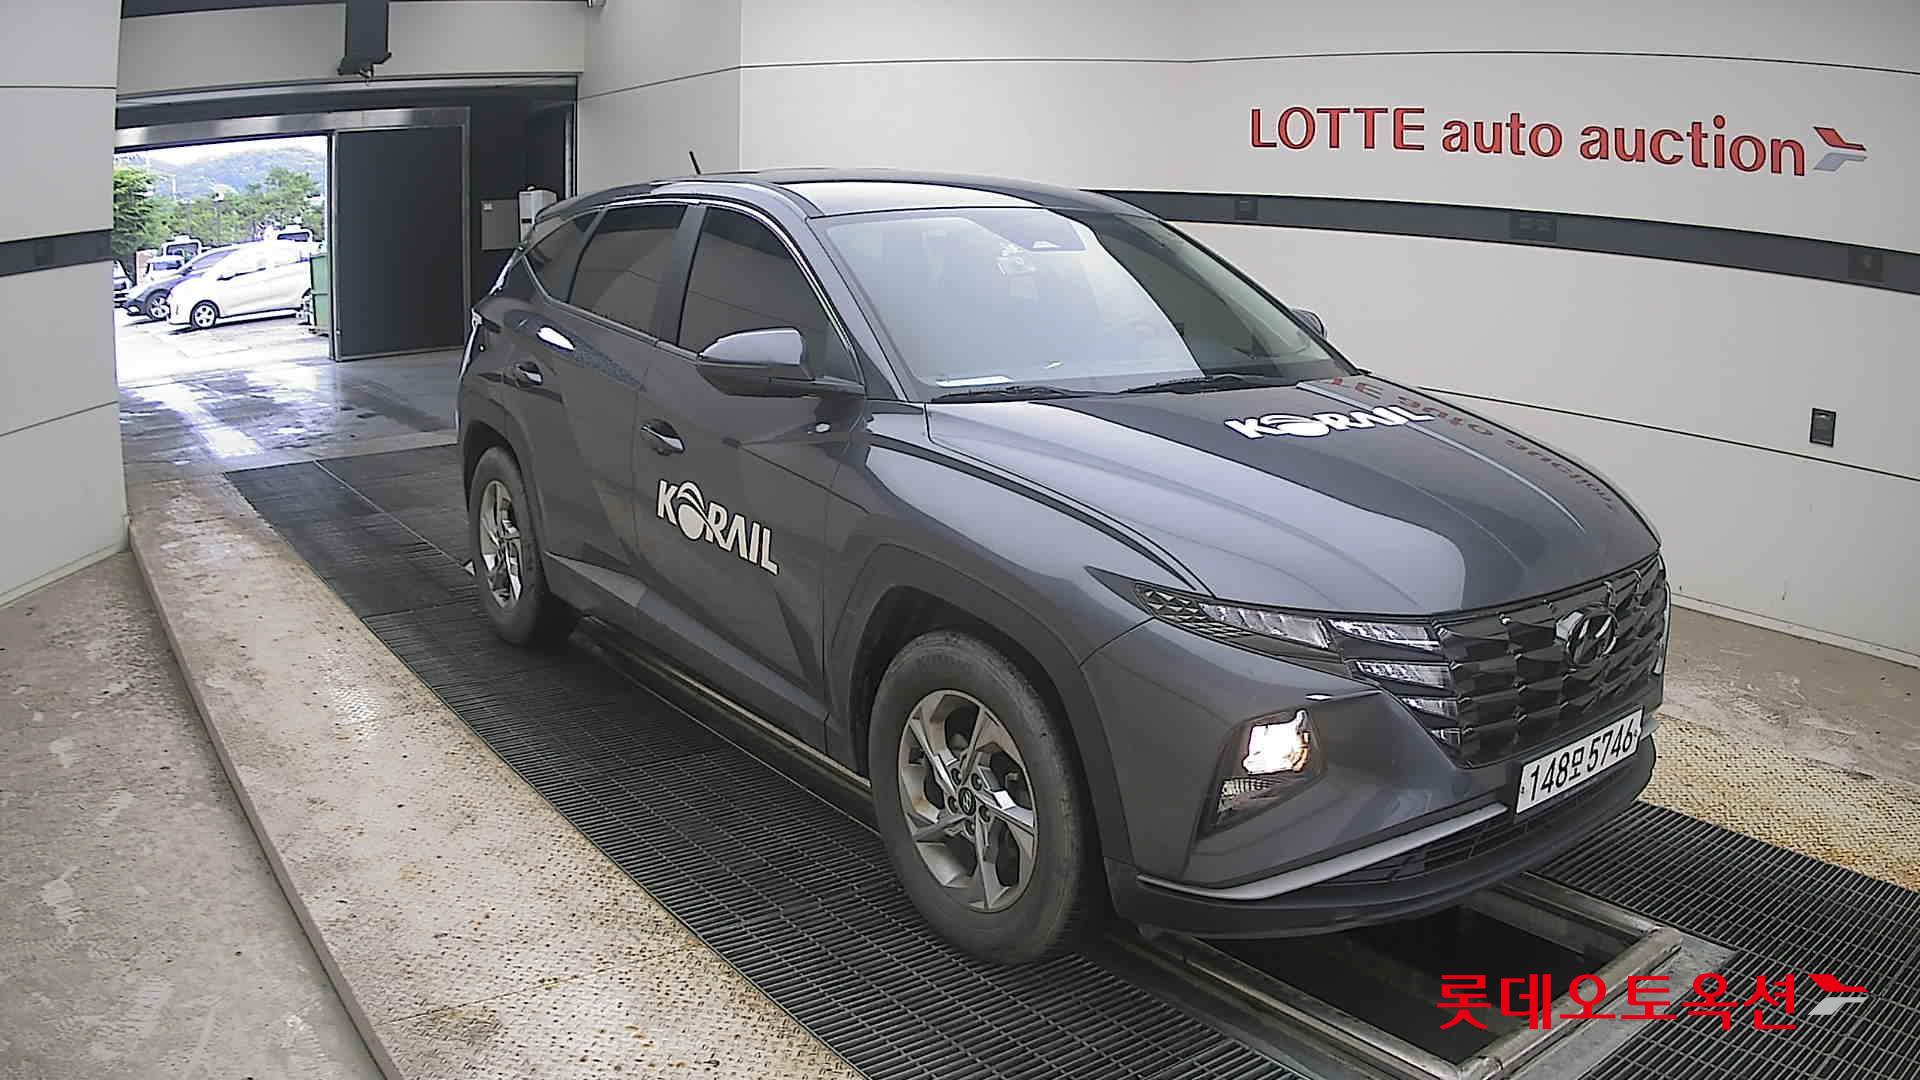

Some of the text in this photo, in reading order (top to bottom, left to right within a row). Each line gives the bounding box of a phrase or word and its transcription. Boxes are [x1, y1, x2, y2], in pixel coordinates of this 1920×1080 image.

[1251, 106, 1805, 177] LOTTE auto auction
[1225, 405, 1435, 439] KORAIL
[656, 479, 779, 576] KORAIL
[1586, 718, 1635, 773] 5746
